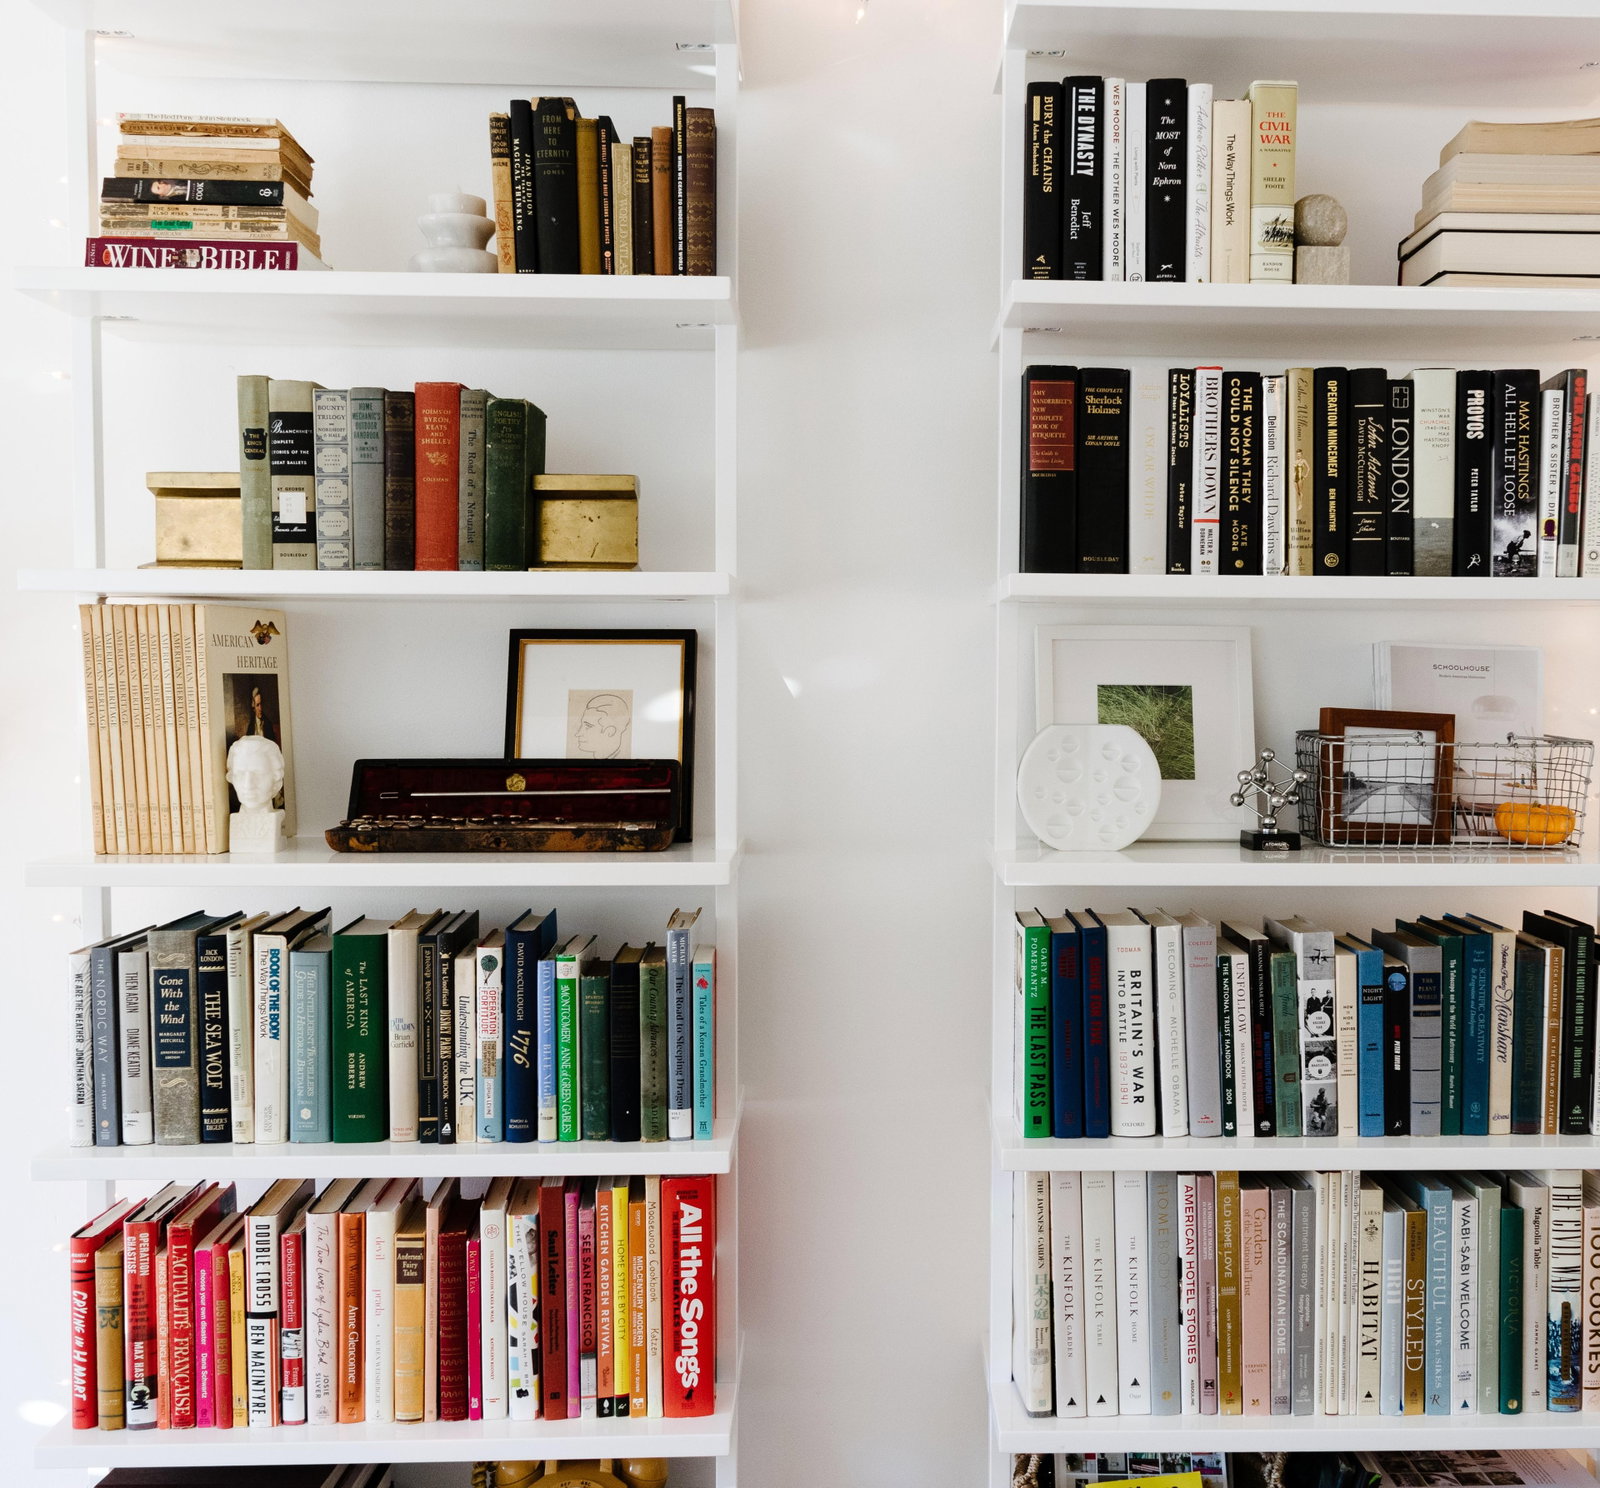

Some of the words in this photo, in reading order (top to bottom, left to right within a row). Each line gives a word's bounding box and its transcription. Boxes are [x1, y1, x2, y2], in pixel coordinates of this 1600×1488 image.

[1043, 96, 1053, 126] BURY
[1077, 88, 1095, 112] THE
[1043, 130, 1051, 144] the
[1155, 132, 1180, 140] MOST
[1226, 134, 1236, 151] The
[1259, 122, 1292, 132] CIVIL
[1260, 134, 1291, 144] WAR
[1077, 117, 1096, 176] DYNASTY
[1224, 152, 1235, 171] Way
[678, 170, 682, 180] WE
[1043, 147, 1052, 193] CHAINS
[1152, 177, 1181, 185] Ephron
[1224, 172, 1235, 201] Things
[1225, 203, 1235, 226] Work
[105, 244, 176, 268] WINE
[200, 246, 280, 270] BIBLE
[1085, 396, 1122, 404] Sherlock
[1086, 405, 1119, 414] Holmes
[1179, 374, 1189, 448] LOYALISTS
[1230, 379, 1240, 422] COULD
[1242, 387, 1252, 410] THE
[1328, 381, 1338, 427] OPERATION
[1505, 384, 1515, 407] ALL
[1204, 377, 1218, 462] BROTHERS
[1466, 390, 1484, 439] PROVOS
[1505, 412, 1515, 443] HELL
[1519, 401, 1529, 431] MAX
[468, 430, 476, 446] The
[1230, 428, 1240, 452] NOT
[1242, 416, 1252, 467] WOMAN
[1328, 429, 1337, 477] MINCEMEAT
[467, 452, 476, 474] Road
[1357, 447, 1365, 502] McCULLOUGH
[1392, 418, 1409, 513] LONDON
[1505, 448, 1515, 471] LET
[1518, 435, 1529, 499] HASTINGS
[467, 479, 476, 488] of
[1204, 466, 1218, 513] DOWN
[1229, 459, 1240, 511] SILENCE
[1242, 471, 1252, 503] THEY
[1267, 456, 1279, 501] Richard
[1504, 475, 1514, 516] LOOSE
[467, 502, 476, 543] Naturalist
[1267, 505, 1279, 554] Dawkins
[211, 633, 254, 648] AMERICAN
[237, 656, 278, 668] HERITAGE
[125, 972, 138, 990] THEN
[159, 976, 183, 985] Gone
[1030, 938, 1038, 997] POMERANTZ
[1040, 974, 1047, 987] M.
[126, 993, 138, 1013] AGAIN
[161, 989, 183, 998] With
[205, 991, 221, 1020] THE
[346, 980, 355, 1029] AMERICA
[360, 979, 368, 1005] LAST
[1237, 962, 1246, 1034] UNFOLLOW
[160, 1014, 184, 1024] Wind
[360, 1009, 368, 1036] KING
[456, 995, 471, 1059] Understanding
[480, 990, 488, 1035] FORTITUDE
[488, 990, 496, 1035] OPERATION
[1030, 1006, 1046, 1030] THE
[1131, 970, 1143, 1057] BRITAIN'S
[1495, 988, 1513, 1062] Manshare
[126, 1029, 139, 1049] DIANE
[206, 1022, 222, 1050] SEA
[510, 1030, 531, 1068] 1776
[1031, 1034, 1046, 1068] LAST
[128, 1052, 140, 1078] KEATON
[206, 1052, 223, 1088] WOLF
[460, 1061, 470, 1074] the
[1119, 1051, 1128, 1106] 1937-1941
[460, 1078, 474, 1106] U.K.
[1030, 1074, 1047, 1107] PASS
[1133, 1067, 1144, 1104] WAR
[1552, 1185, 1581, 1212] THE
[600, 1205, 609, 1254] KITCHEN
[648, 1202, 656, 1255] Moosewood
[680, 1202, 701, 1243] All
[1185, 1185, 1195, 1256] AMERICAN
[1254, 1208, 1266, 1265] Gardens
[1552, 1219, 1580, 1258] CIVIL
[127, 1236, 137, 1274] CHASTISE
[139, 1233, 149, 1276] OPERATION
[255, 1224, 271, 1267] DOUBLE
[1432, 1205, 1446, 1310] BEAUTIFUL
[1461, 1205, 1470, 1276] WABI-SABI
[601, 1258, 610, 1306] GARDEN
[650, 1260, 658, 1303] Cookbook
[680, 1246, 701, 1294] the
[1186, 1261, 1195, 1304] HOTEL
[1277, 1222, 1287, 1315] SCANDINAVIAN
[1551, 1266, 1580, 1293] WAR
[255, 1272, 272, 1306] CROSS
[1063, 1256, 1074, 1322] KINFOLK
[73, 1291, 87, 1332] CRYING
[348, 1305, 358, 1330] Anne
[1362, 1261, 1378, 1360] HABITAT
[1406, 1279, 1423, 1371] STYLED
[1460, 1280, 1470, 1350] WELCOME
[74, 1335, 83, 1344] IN
[251, 1325, 265, 1346] BEN
[601, 1309, 610, 1356] REVIVAL
[651, 1328, 659, 1356] Katzen
[675, 1298, 703, 1387] Songs
[1186, 1309, 1196, 1364] STORIES
[1277, 1319, 1286, 1354] HOME
[73, 1350, 85, 1362] H
[348, 1332, 358, 1384] Glenconner
[73, 1364, 86, 1401] MART
[171, 1338, 190, 1415] FRANÇAISE
[251, 1351, 267, 1414] MACINTYRE
